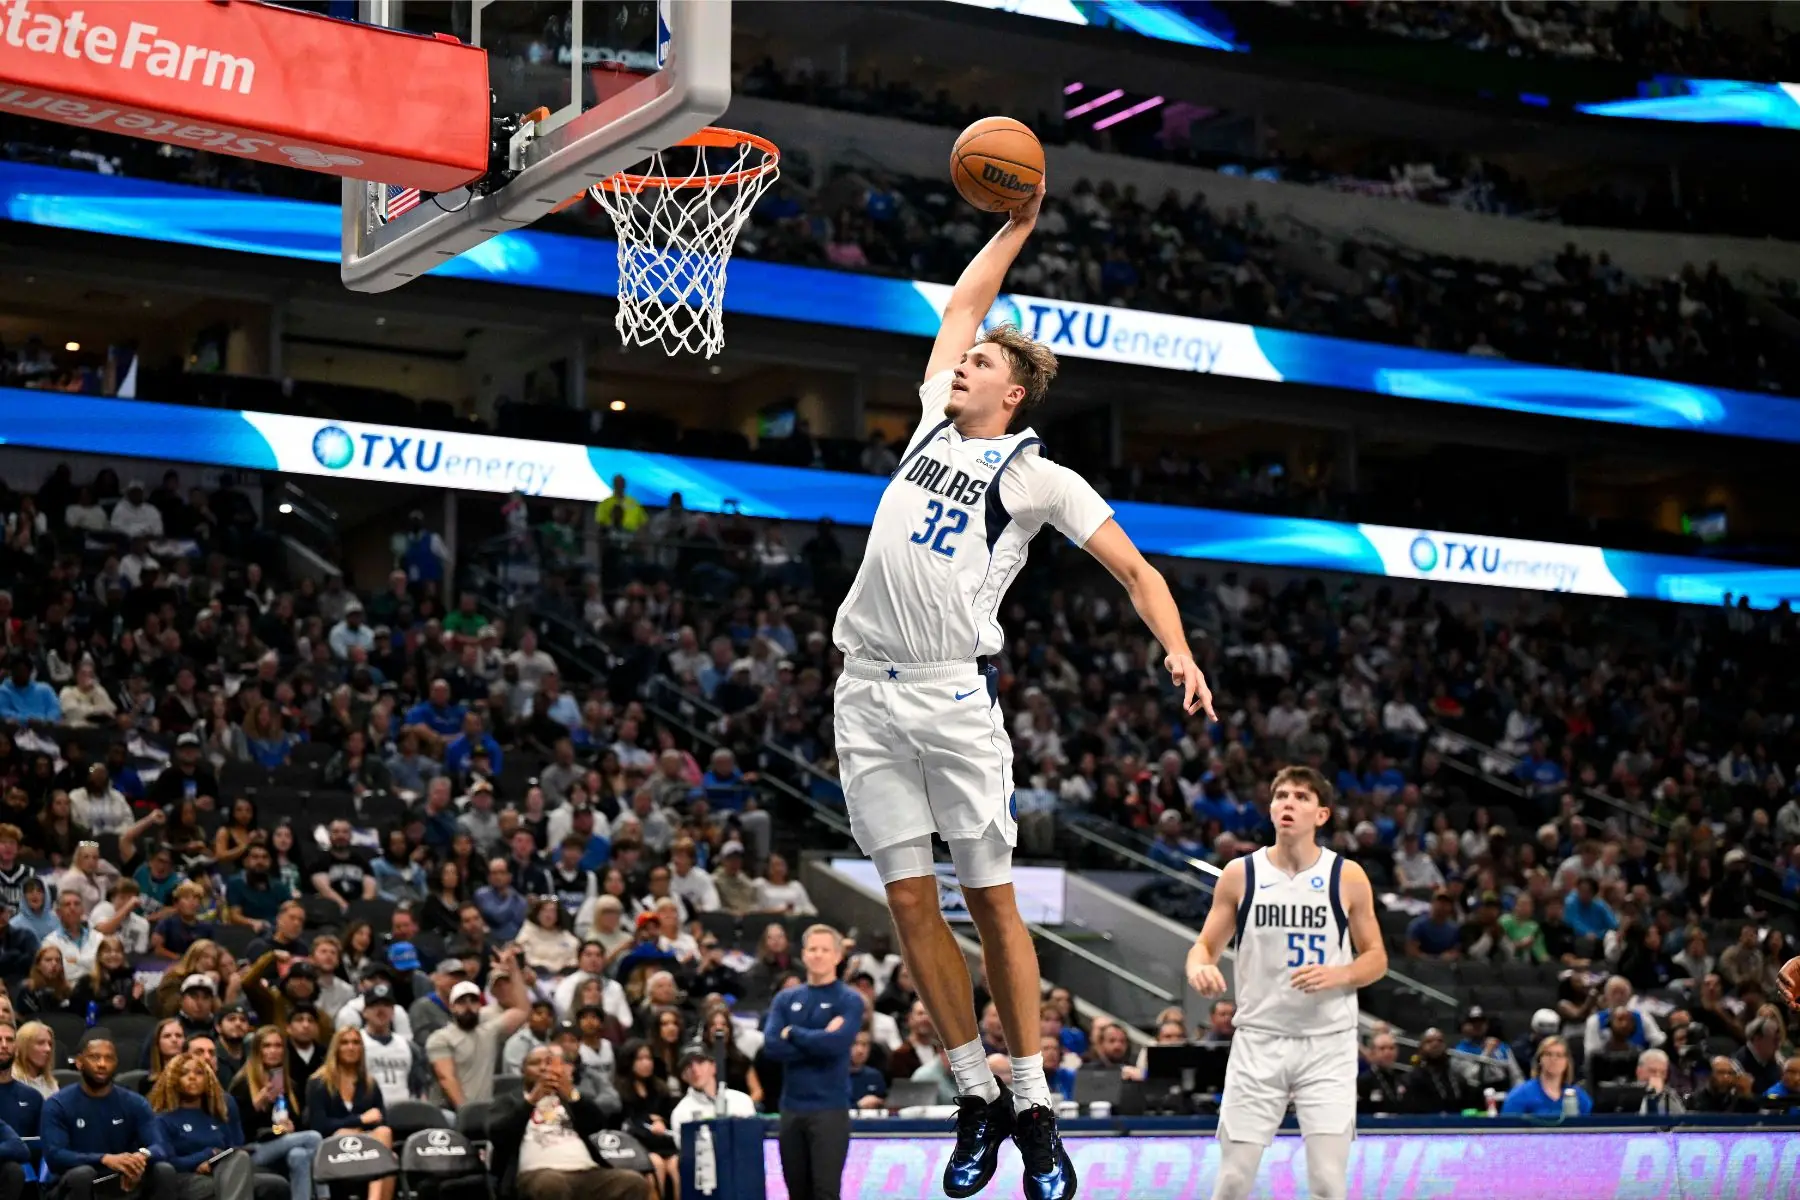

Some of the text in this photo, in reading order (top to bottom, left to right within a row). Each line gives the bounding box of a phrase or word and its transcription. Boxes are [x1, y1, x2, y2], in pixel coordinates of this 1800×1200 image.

[0, 0, 255, 94] tateFarm
[983, 162, 1036, 193] Wilson
[1029, 305, 1222, 373] TXU energy
[361, 433, 555, 495] TXU energy
[904, 455, 988, 506] DALAS
[976, 458, 998, 470] CHASE
[910, 499, 969, 558] 32
[1444, 542, 1580, 592] TXU energy
[1254, 904, 1327, 928] DALLAS
[1287, 933, 1326, 967] 55
